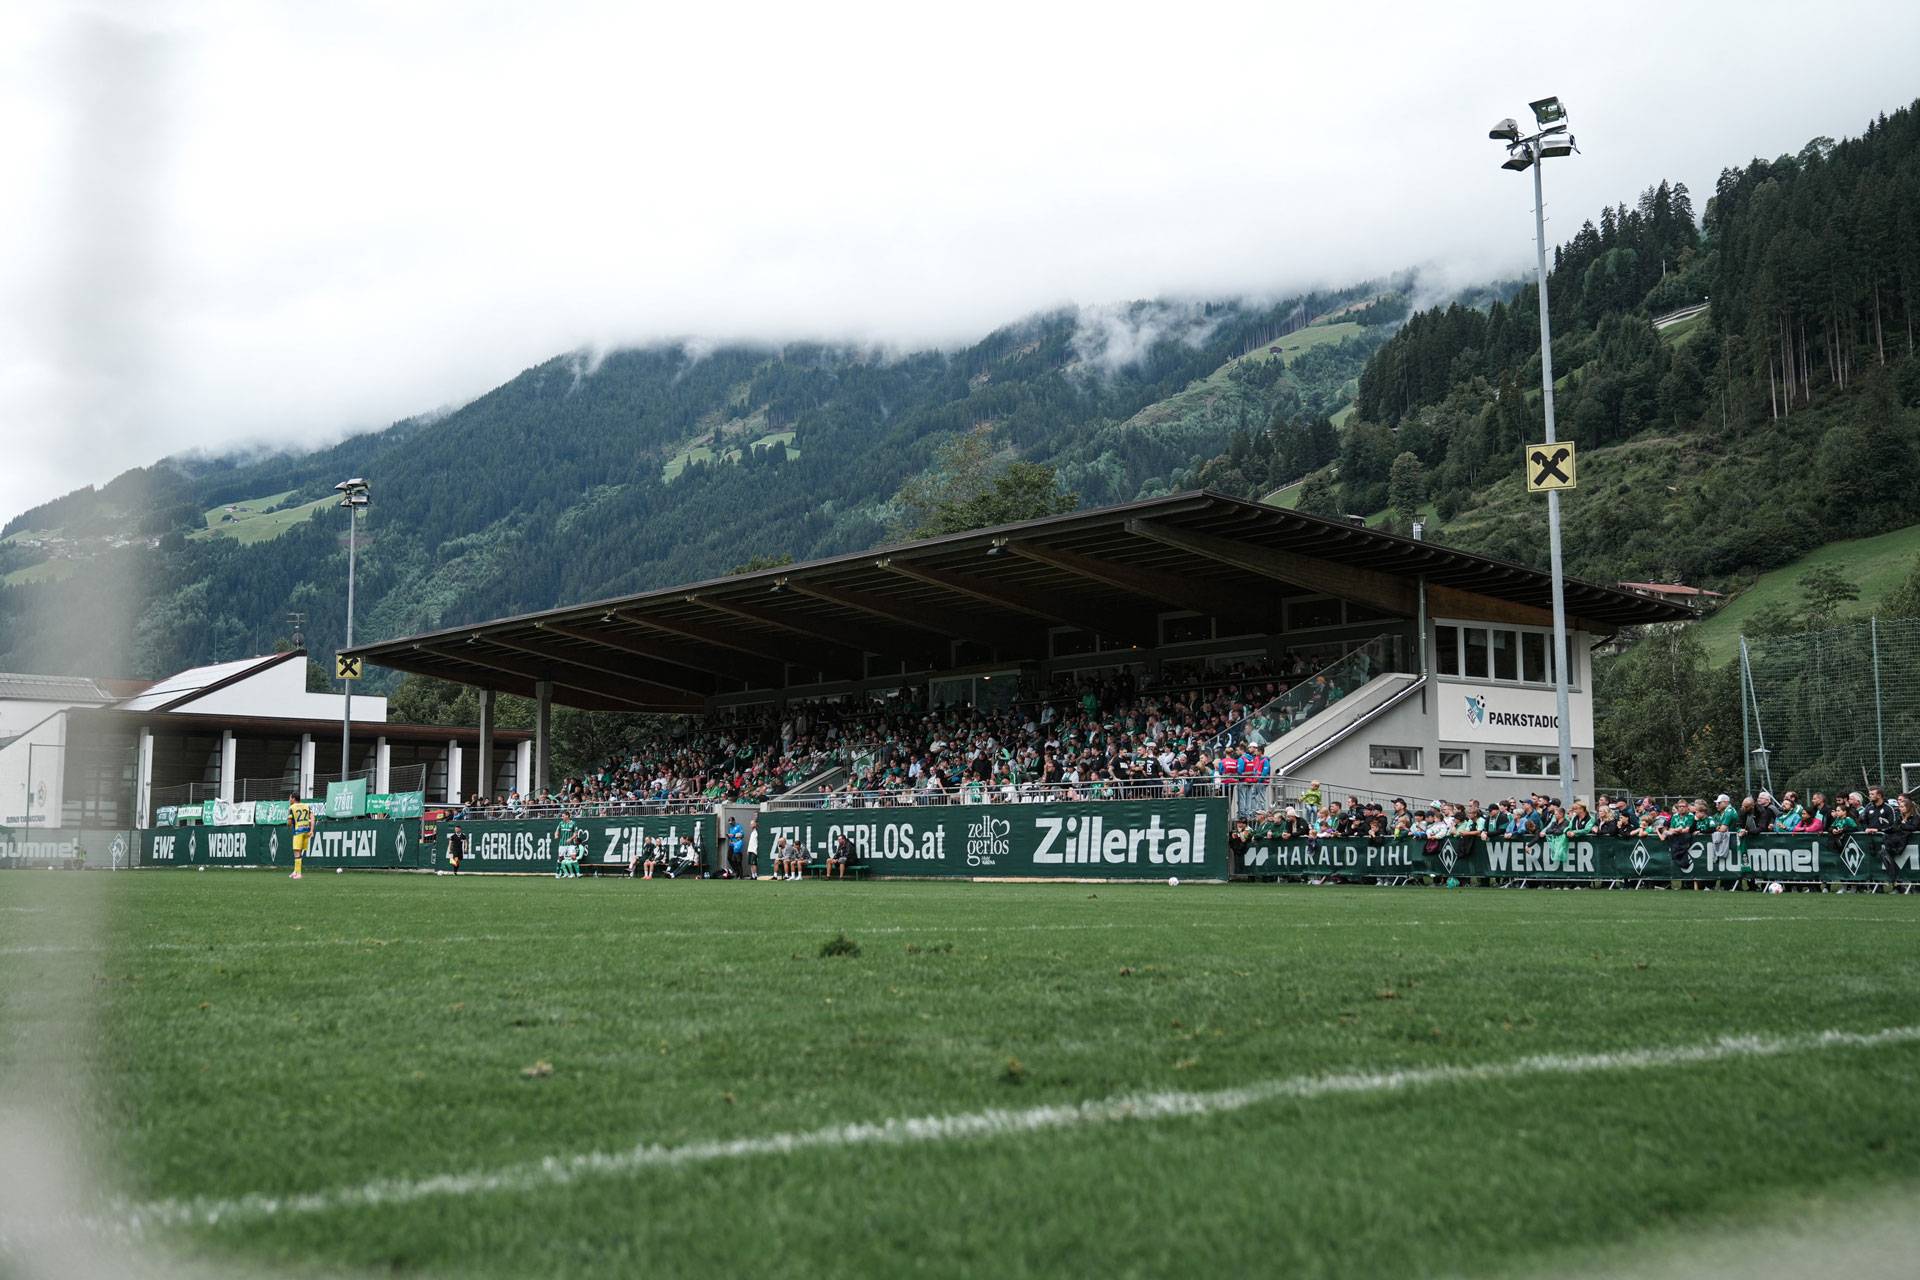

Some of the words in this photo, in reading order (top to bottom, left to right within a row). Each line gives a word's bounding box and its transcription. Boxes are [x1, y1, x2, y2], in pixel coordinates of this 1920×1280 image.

[296, 809, 309, 822] 22
[968, 815, 991, 838] zell
[153, 836, 176, 859] EWE
[208, 832, 247, 858] WERDER
[966, 832, 1009, 867] gerlos
[1033, 814, 1207, 864] Zillertal
[1277, 846, 1358, 866] HARALD
[1366, 845, 1413, 867] PIHL
